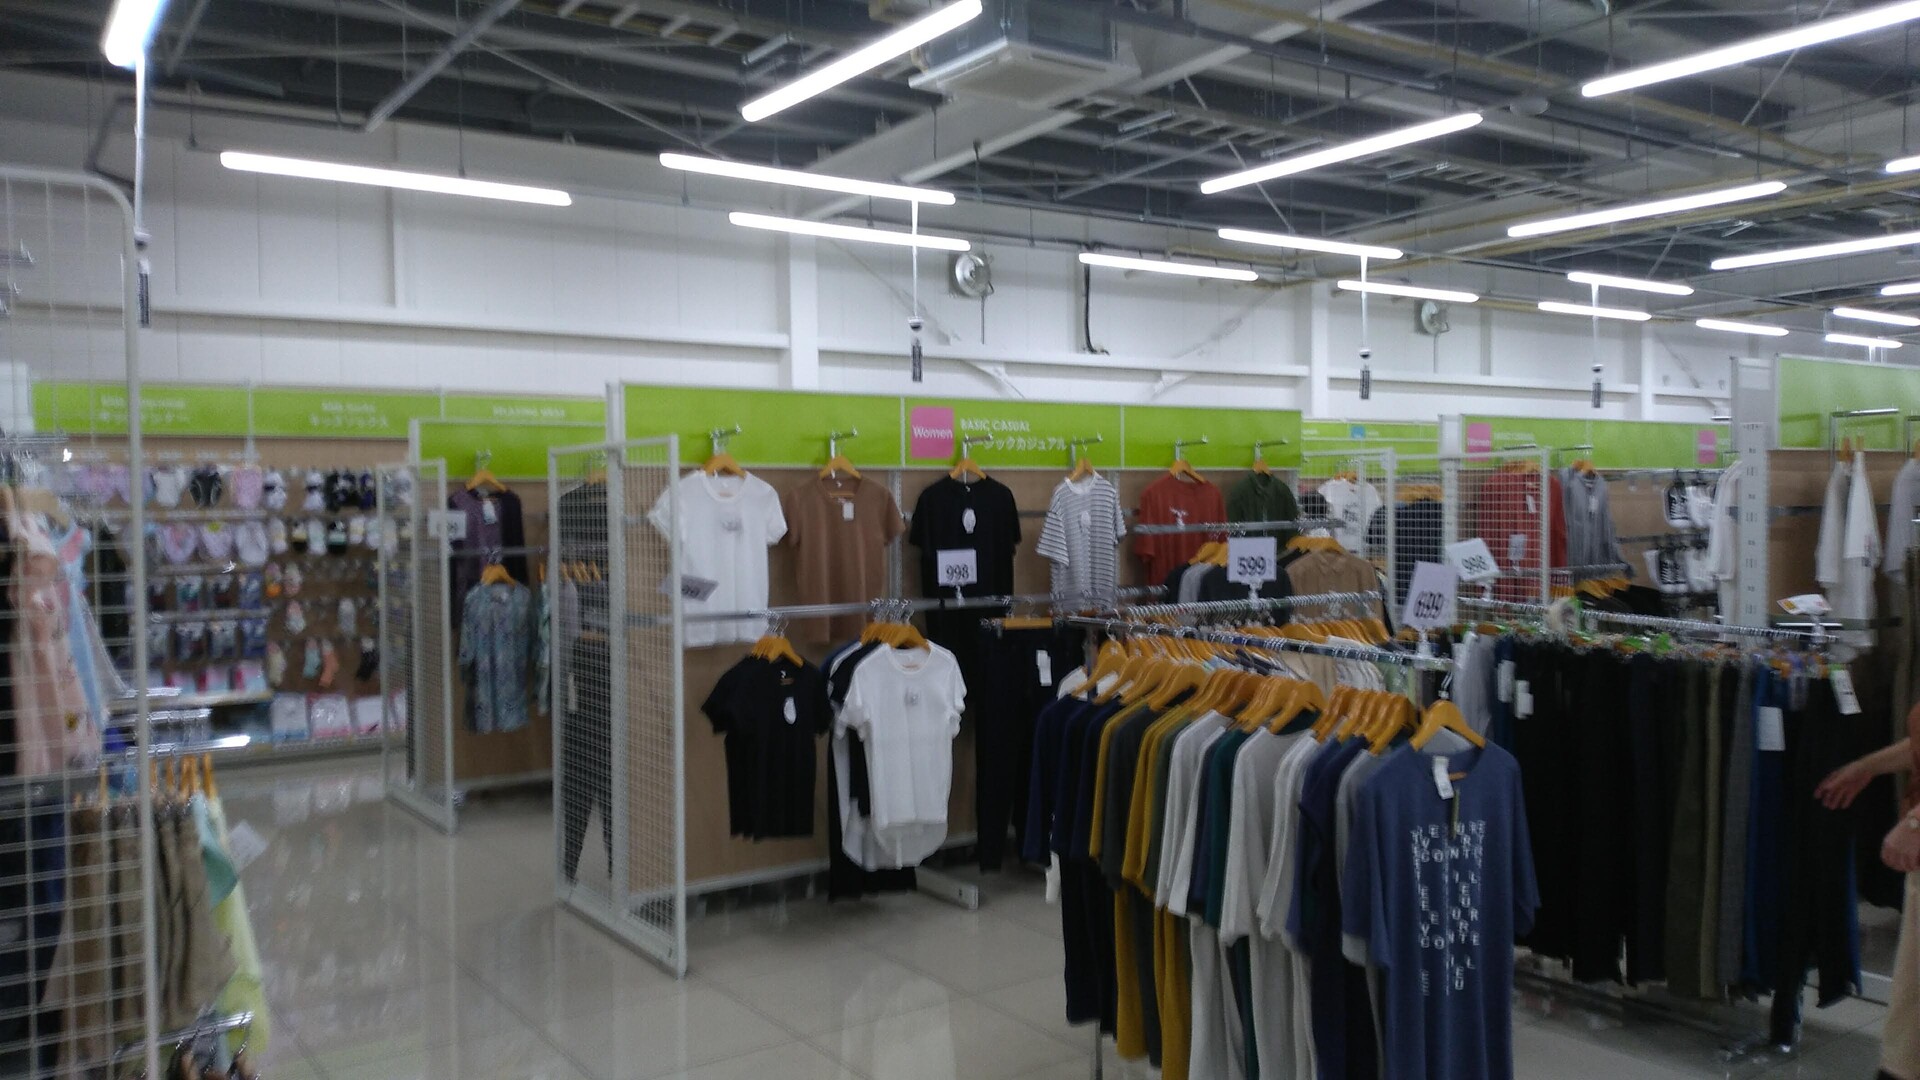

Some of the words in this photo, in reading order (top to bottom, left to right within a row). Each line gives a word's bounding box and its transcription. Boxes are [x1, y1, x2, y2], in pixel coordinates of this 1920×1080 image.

[912, 425, 953, 439] Women
[960, 418, 990, 431] BASIC
[992, 420, 1030, 432] CASUAL
[945, 563, 970, 581] 998
[1237, 556, 1267, 576] 599
[1413, 591, 1446, 619] 699
